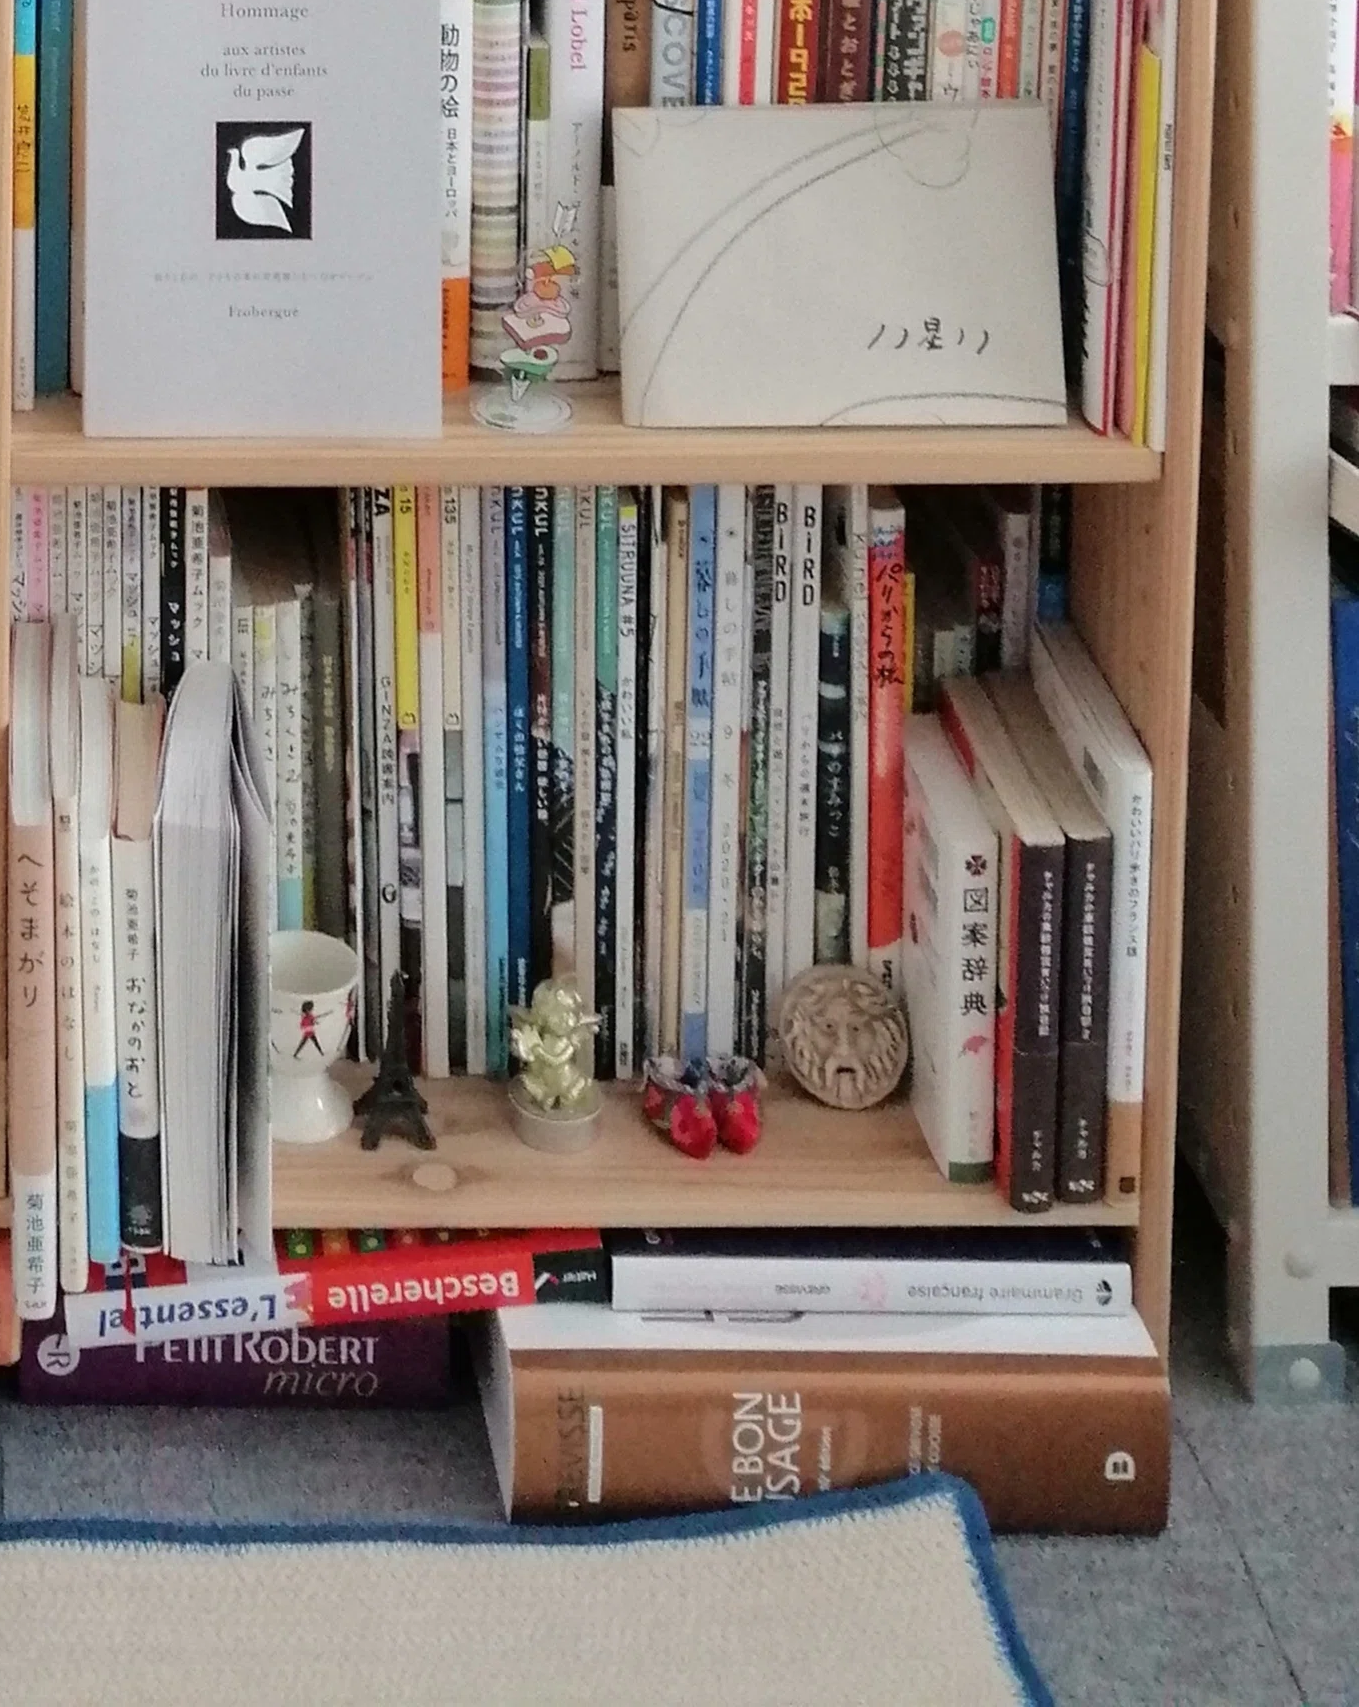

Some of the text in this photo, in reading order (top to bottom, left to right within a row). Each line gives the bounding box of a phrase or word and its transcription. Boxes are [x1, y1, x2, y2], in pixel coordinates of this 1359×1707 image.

[220, 1, 309, 22] Hommage
[223, 42, 307, 58] aux artistes
[570, 13, 587, 72] Lobel
[200, 62, 328, 78] du livre d'enfants
[233, 82, 251, 99] du
[441, 23, 459, 218] 動物の絵 日本とヨーロッパ
[961, 886, 989, 1016] 図案辞典
[17, 851, 45, 1295] へそまがり 菊池亜希子
[326, 1261, 523, 1314] Bescherelle
[995, 1281, 1086, 1304] Grammaire
[97, 1285, 278, 1343] L'essentel
[262, 1367, 379, 1400] micro
